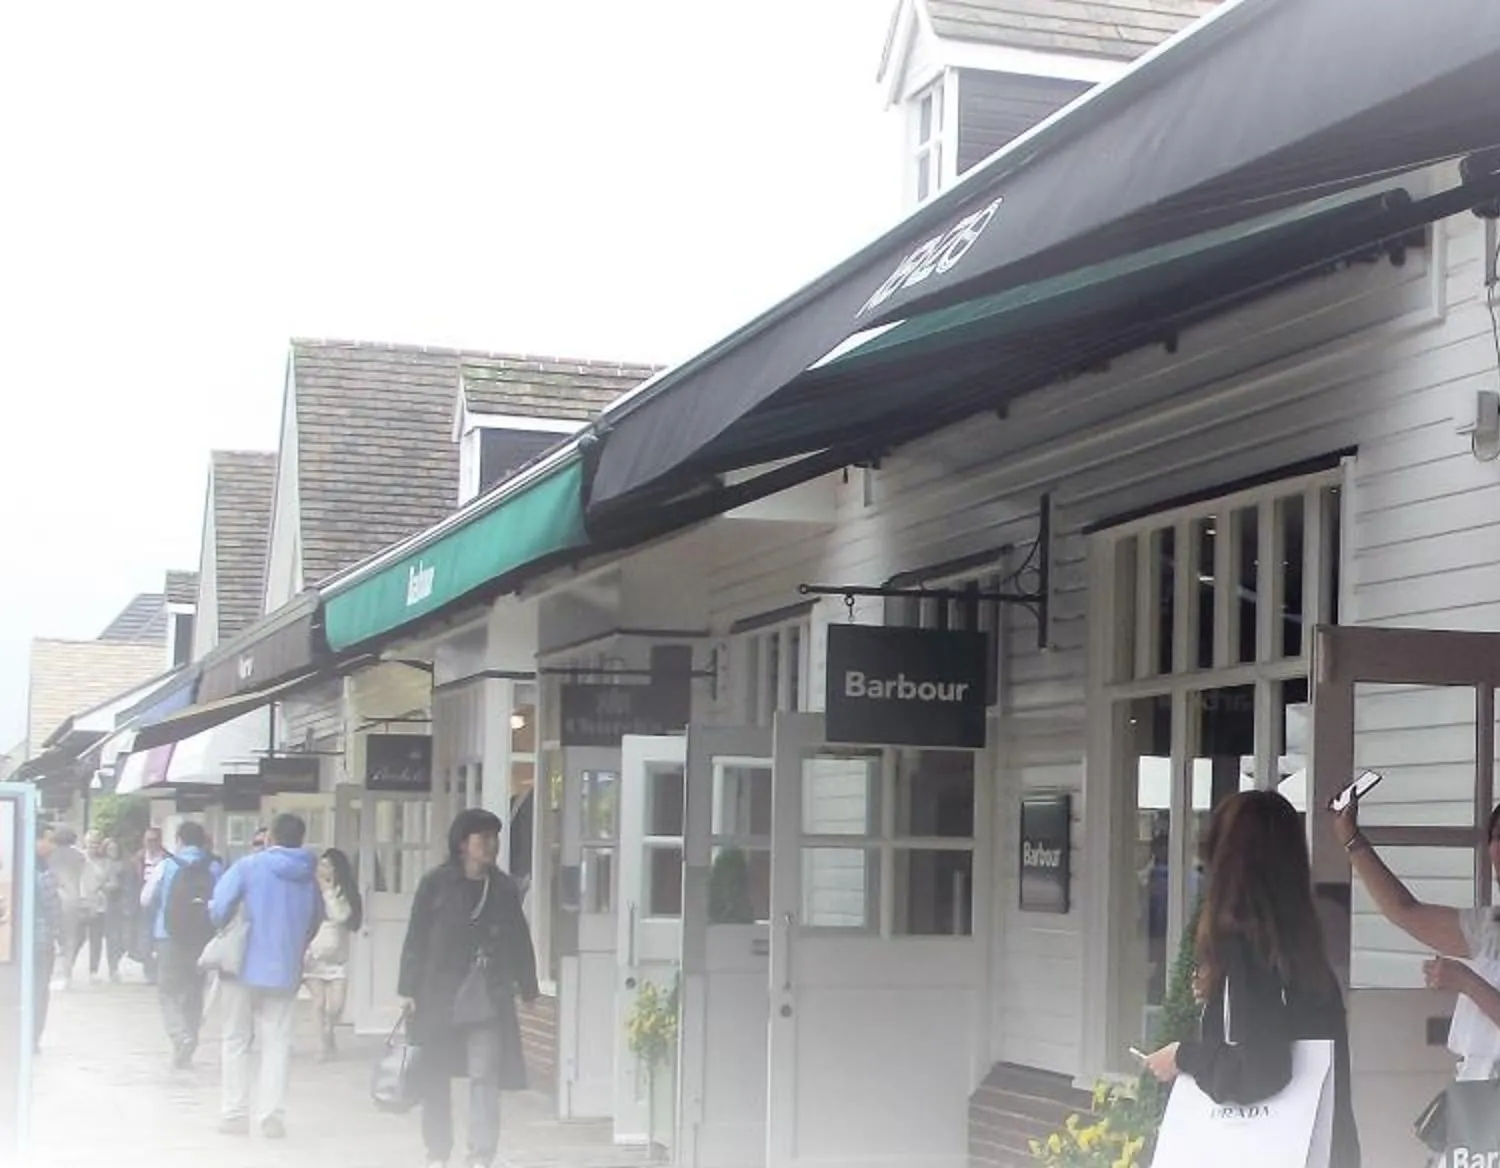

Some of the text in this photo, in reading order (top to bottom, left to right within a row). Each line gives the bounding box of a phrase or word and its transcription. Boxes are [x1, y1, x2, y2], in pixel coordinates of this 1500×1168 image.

[845, 671, 969, 701] Barbour
[1023, 840, 1062, 867] Barbour
[1210, 1104, 1270, 1119] PRADA
